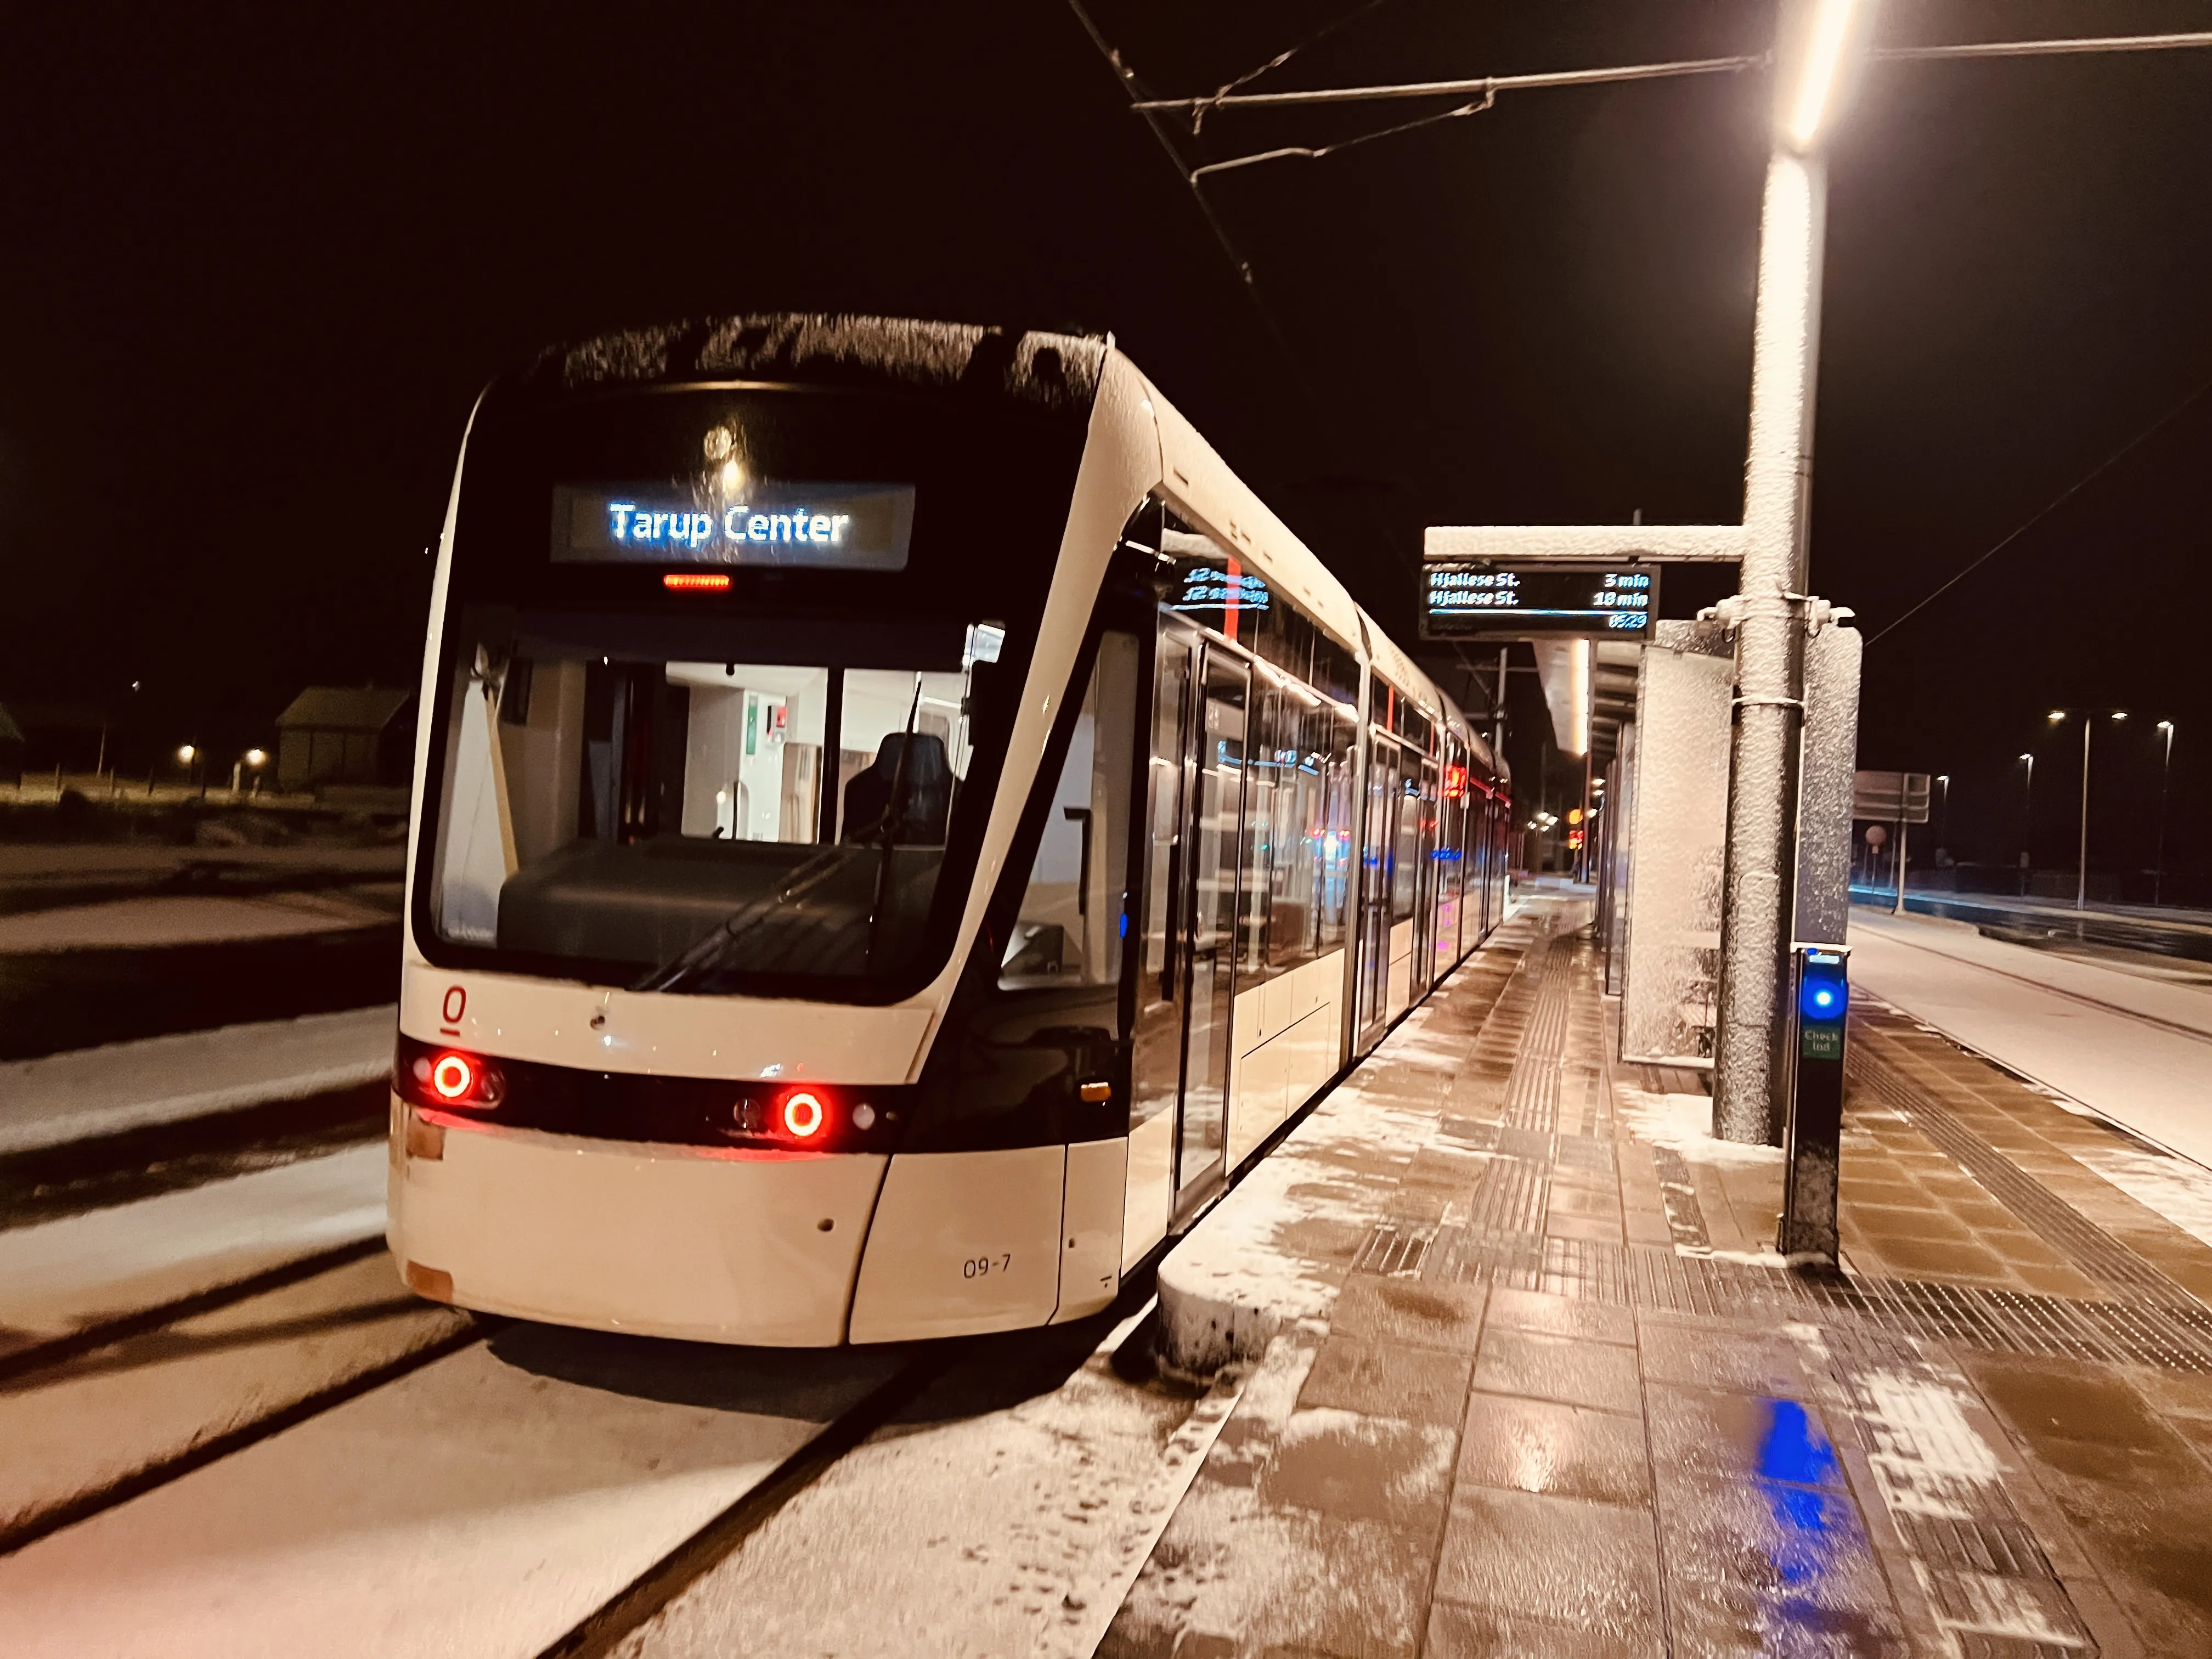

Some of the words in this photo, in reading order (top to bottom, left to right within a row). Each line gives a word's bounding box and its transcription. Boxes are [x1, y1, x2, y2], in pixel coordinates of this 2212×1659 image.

[610, 501, 713, 548] Tarup
[724, 504, 849, 543] Center
[1430, 572, 1494, 588] Hjallese
[1496, 573, 1520, 587] St.
[1604, 573, 1617, 588] 3
[1618, 574, 1650, 588] min
[1429, 590, 1494, 606] Hjallese
[1494, 590, 1519, 605] St.
[1617, 592, 1649, 607] min
[1804, 1030, 1839, 1042] Check
[964, 1253, 1011, 1279] 09-7
